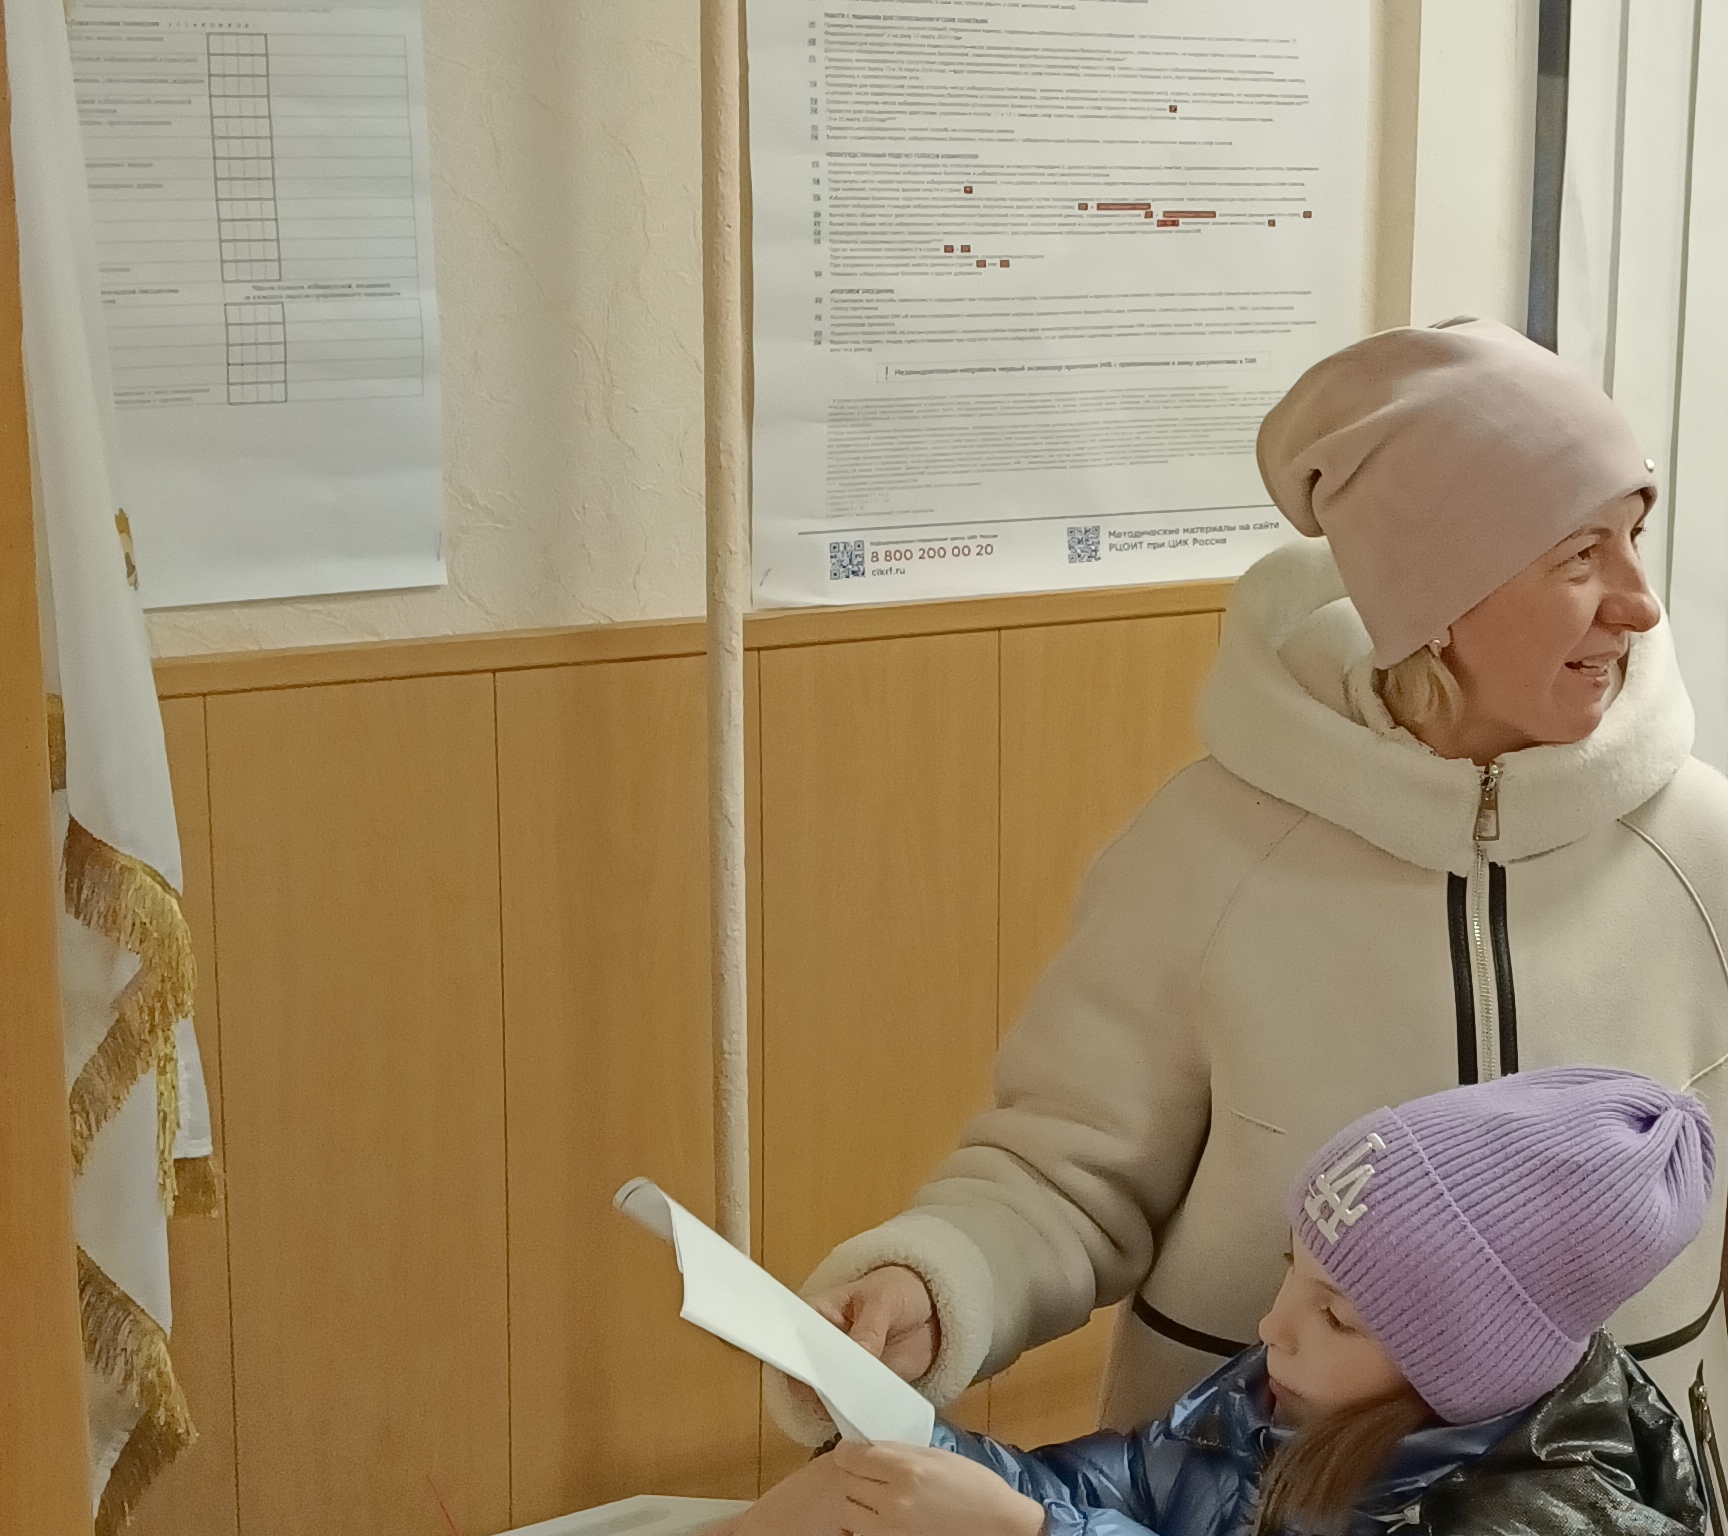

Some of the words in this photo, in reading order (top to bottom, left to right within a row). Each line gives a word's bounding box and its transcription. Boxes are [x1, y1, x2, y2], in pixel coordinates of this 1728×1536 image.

[1183, 523, 1236, 535] материалы
[1253, 520, 1280, 531] сайте
[1108, 541, 1143, 553] РЦОИТ
[1168, 538, 1189, 549] ЦИК
[1192, 536, 1227, 546] России
[871, 551, 880, 563] 8
[884, 549, 914, 562] 800
[918, 547, 947, 560] 200
[951, 545, 971, 557] 00
[975, 544, 994, 556] 20
